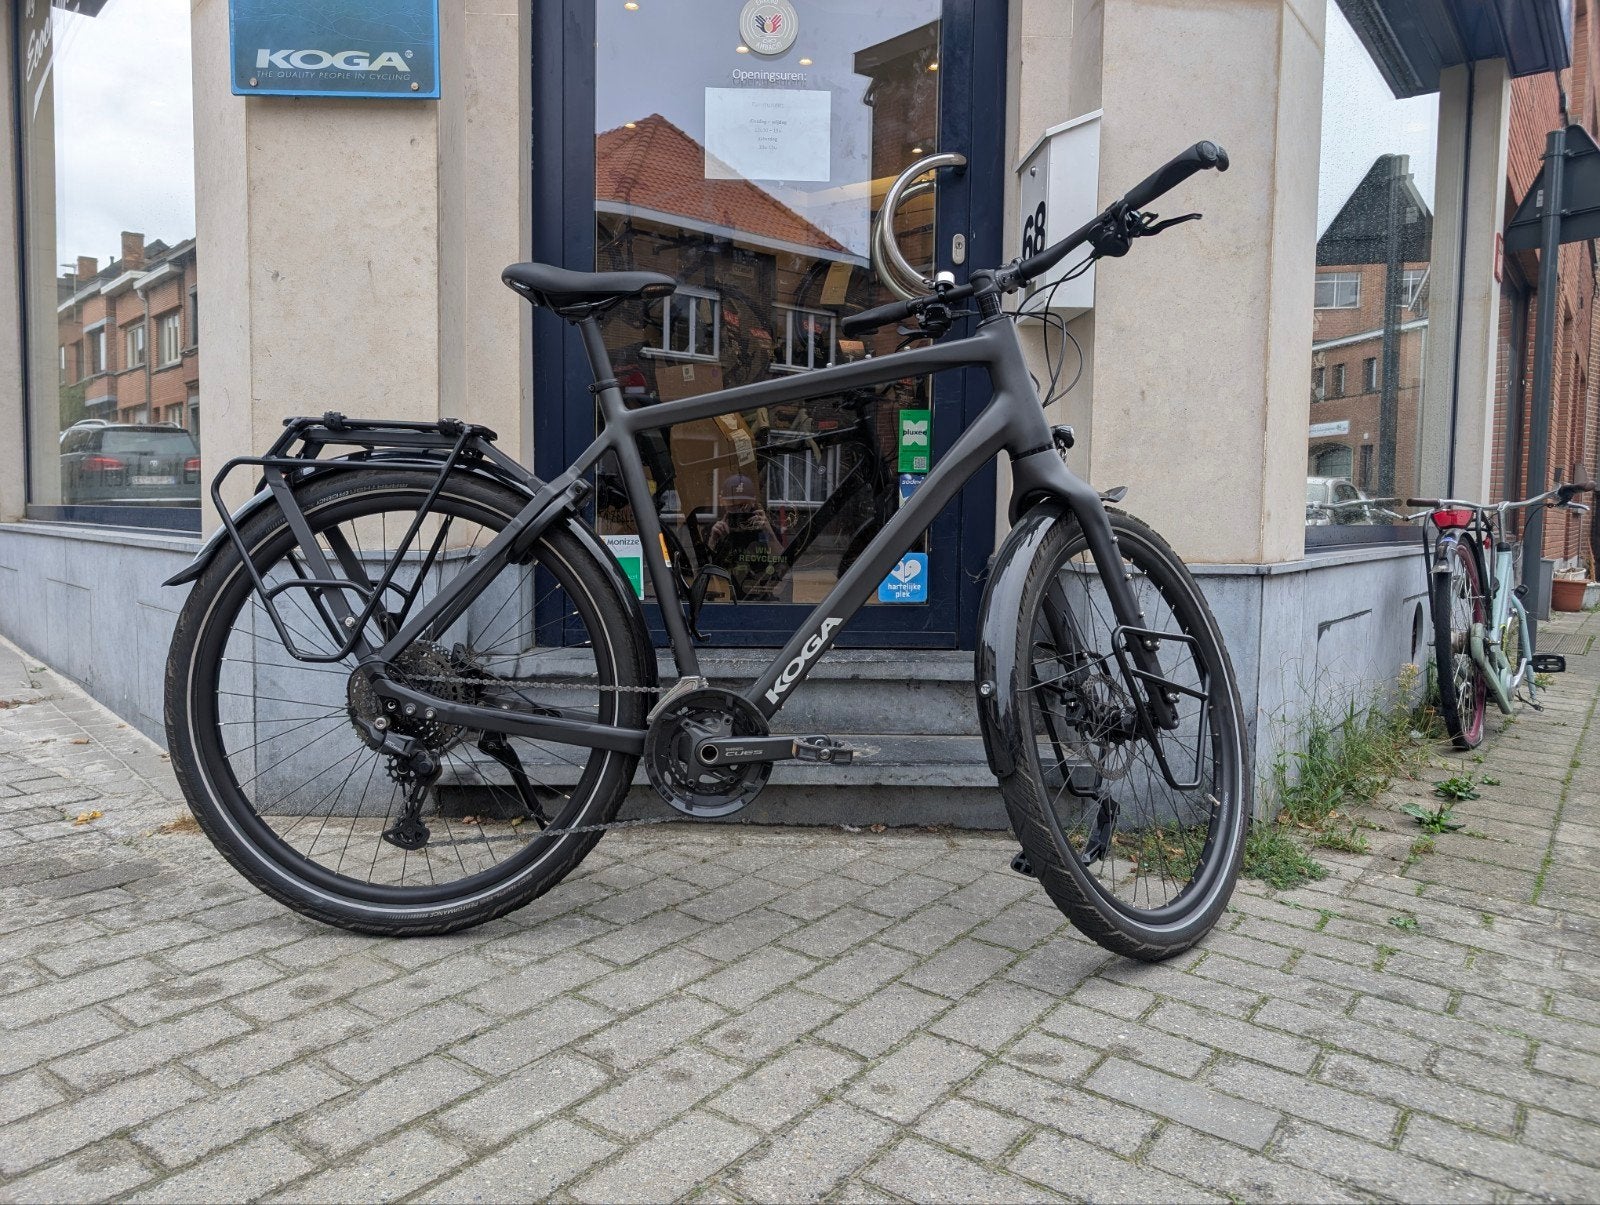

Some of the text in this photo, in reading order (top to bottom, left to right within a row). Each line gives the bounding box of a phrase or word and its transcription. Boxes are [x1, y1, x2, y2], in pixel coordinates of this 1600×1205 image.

[256, 49, 411, 71] KOGA
[257, 70, 412, 81] THE QUALITY PEOPLE IN CYCLING
[732, 69, 807, 82] Openingsuren:
[1022, 200, 1047, 262] 68
[903, 427, 928, 436] pluxee
[606, 537, 640, 546] Monizze
[755, 546, 772, 554] WIJ
[887, 582, 922, 591] hartelijke
[895, 591, 911, 599] plek
[765, 617, 844, 705] KOGA
[430, 901, 478, 917] PERFORMANCE
